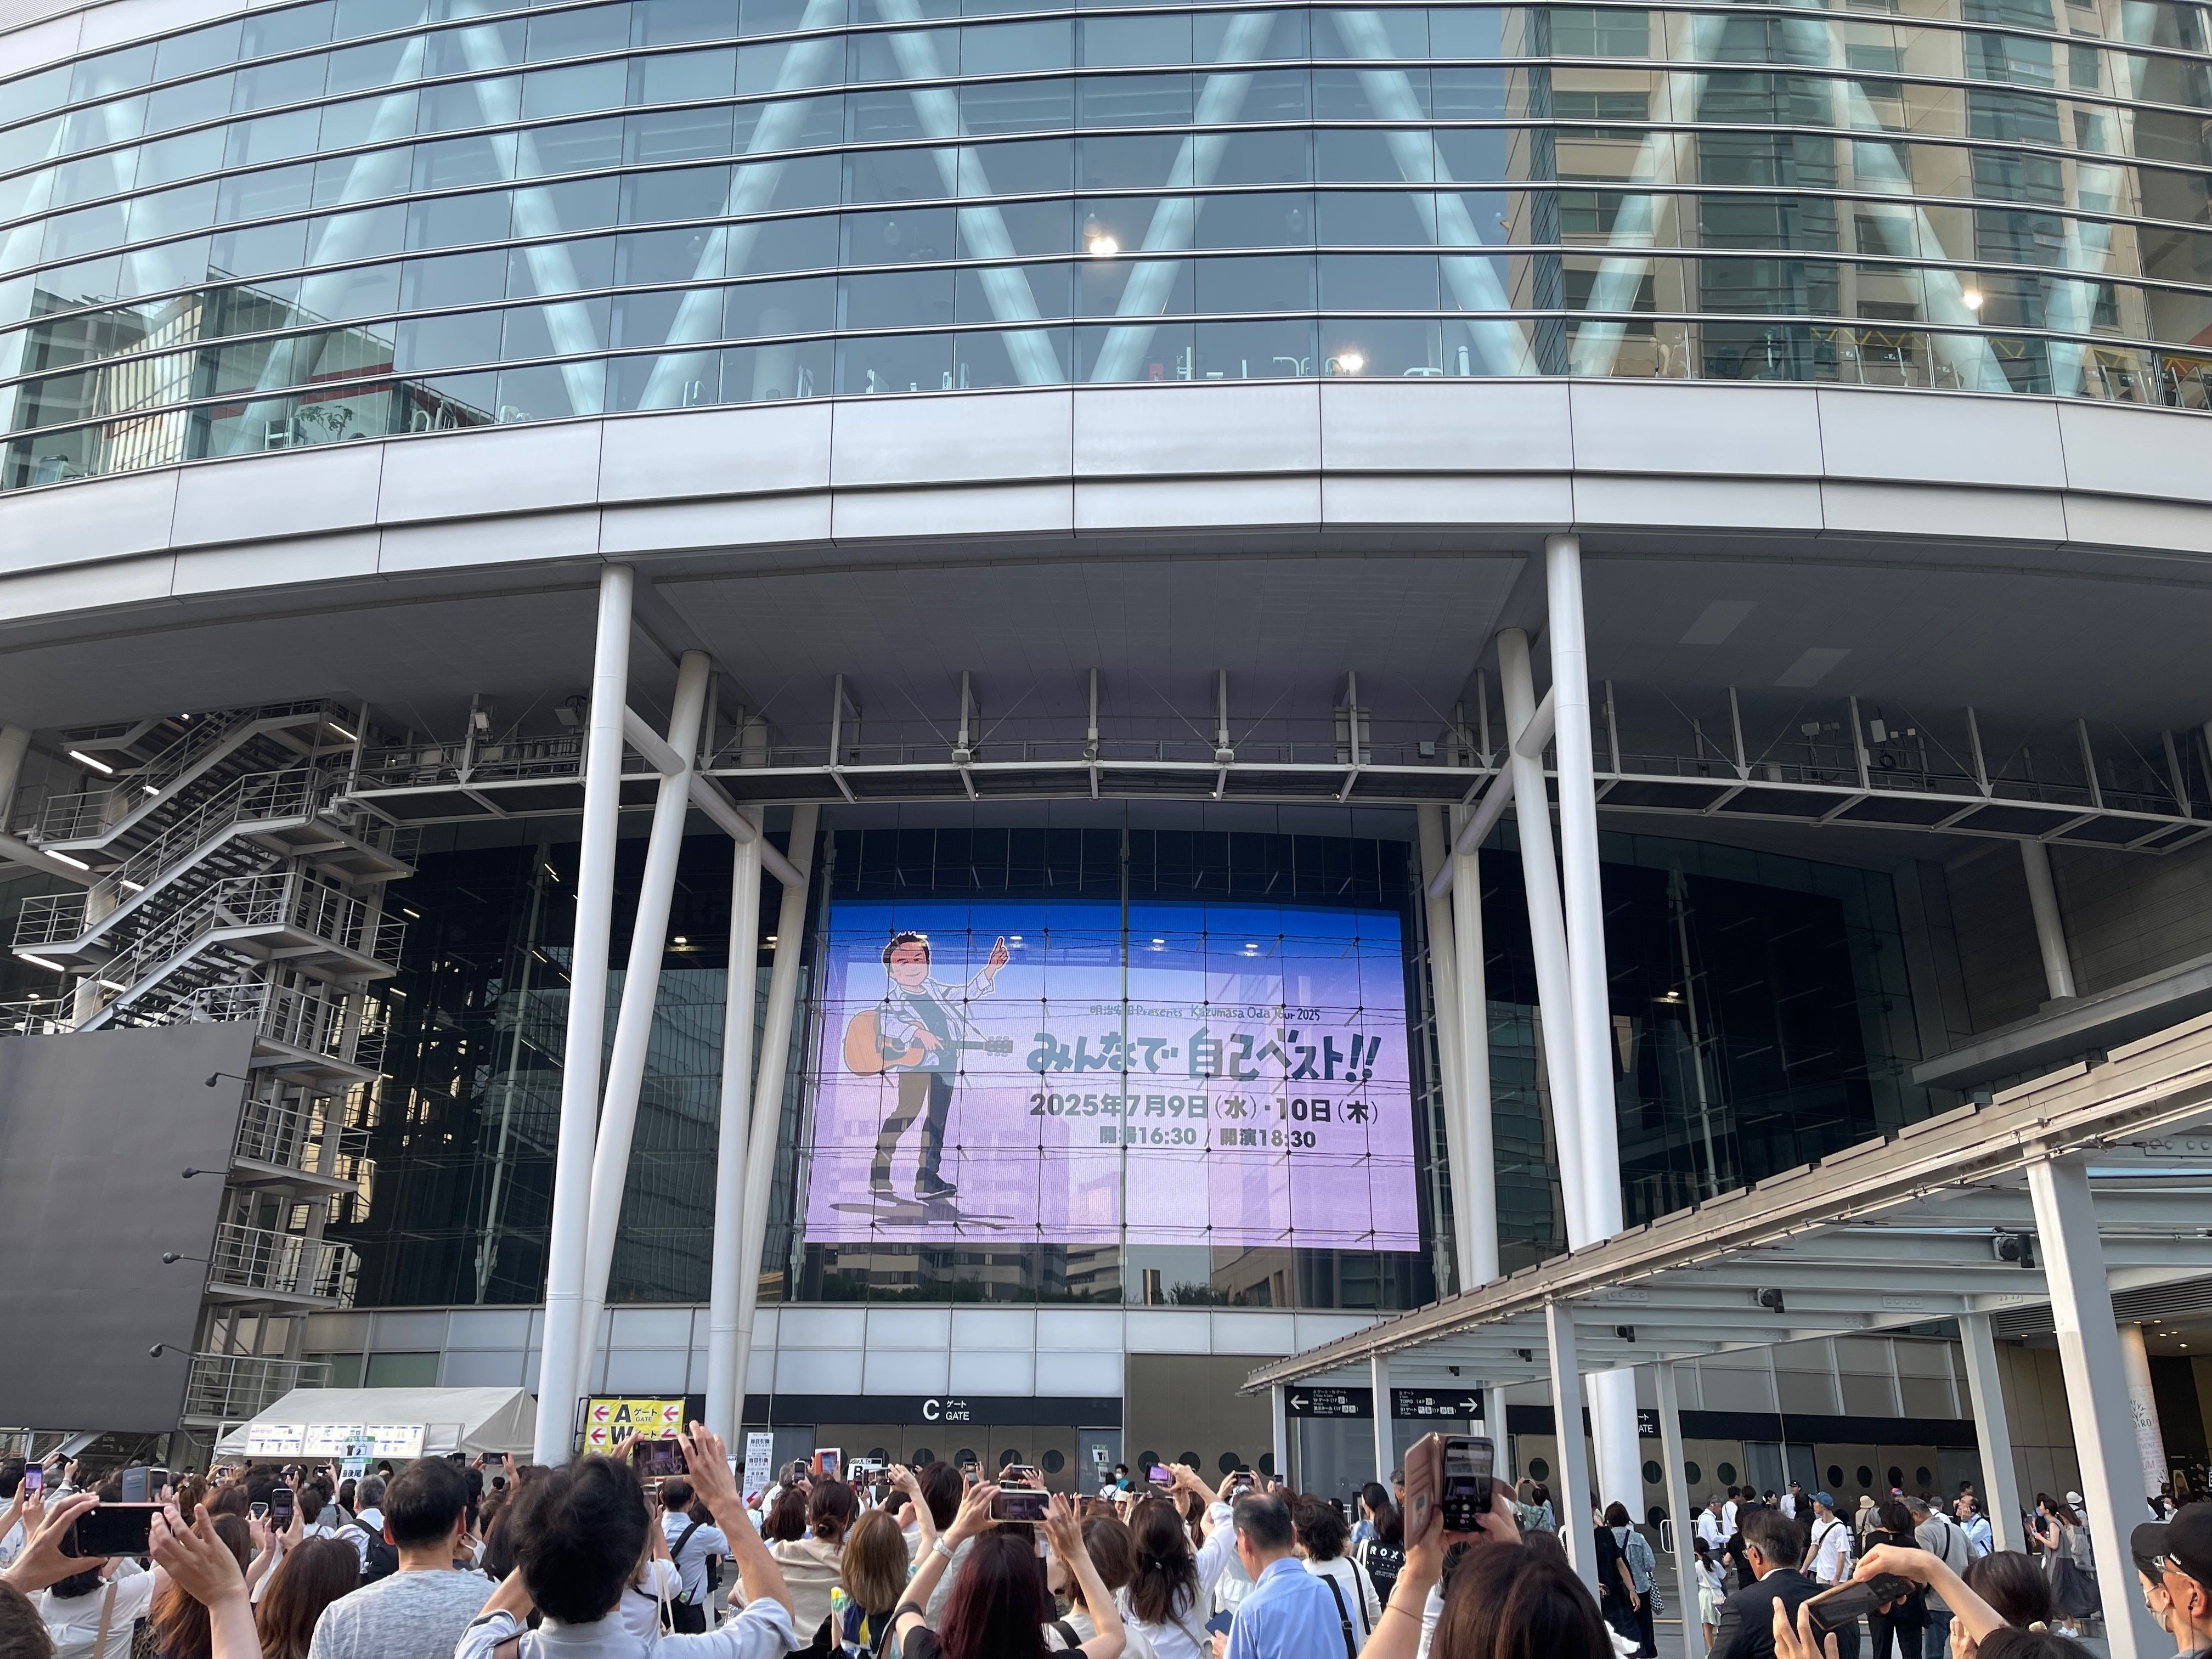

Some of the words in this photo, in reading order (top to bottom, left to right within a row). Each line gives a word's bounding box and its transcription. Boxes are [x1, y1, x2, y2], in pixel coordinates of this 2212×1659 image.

[1137, 1005, 1183, 1017] Presents
[1191, 1004, 1245, 1018] Kazumasa
[1247, 1007, 1271, 1019] Oda
[1272, 1007, 1295, 1019] Tour
[1297, 1008, 1321, 1021] 2025
[613, 1404, 631, 1423] A
[634, 1408, 657, 1417] ゲート
[923, 1399, 940, 1420] C
[946, 1400, 967, 1408] ゲート
[945, 1411, 970, 1420] GATE
[610, 1426, 634, 1445] W
[637, 1430, 657, 1438] ート
[1639, 1424, 1654, 1433] ATE
